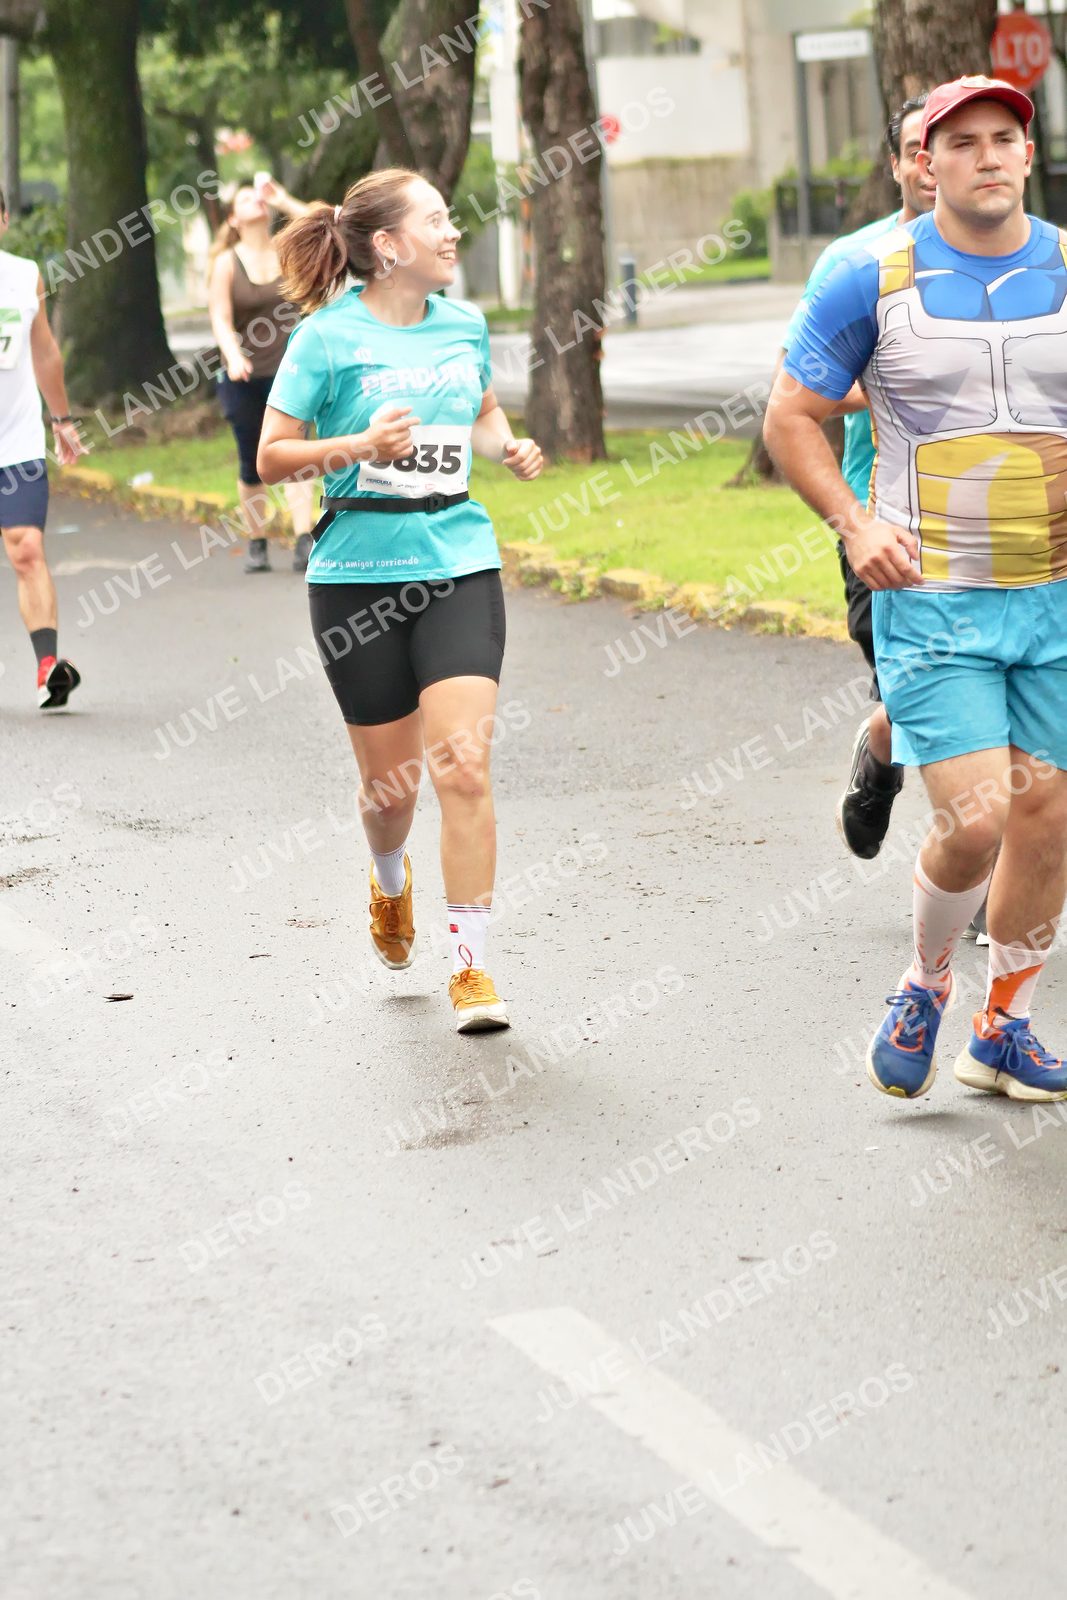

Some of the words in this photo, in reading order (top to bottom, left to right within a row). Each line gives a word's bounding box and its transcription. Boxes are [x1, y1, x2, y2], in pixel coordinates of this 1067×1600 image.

[991, 32, 1043, 68] LTO
[345, 560, 374, 570] amigos
[376, 556, 419, 568] corriendo
